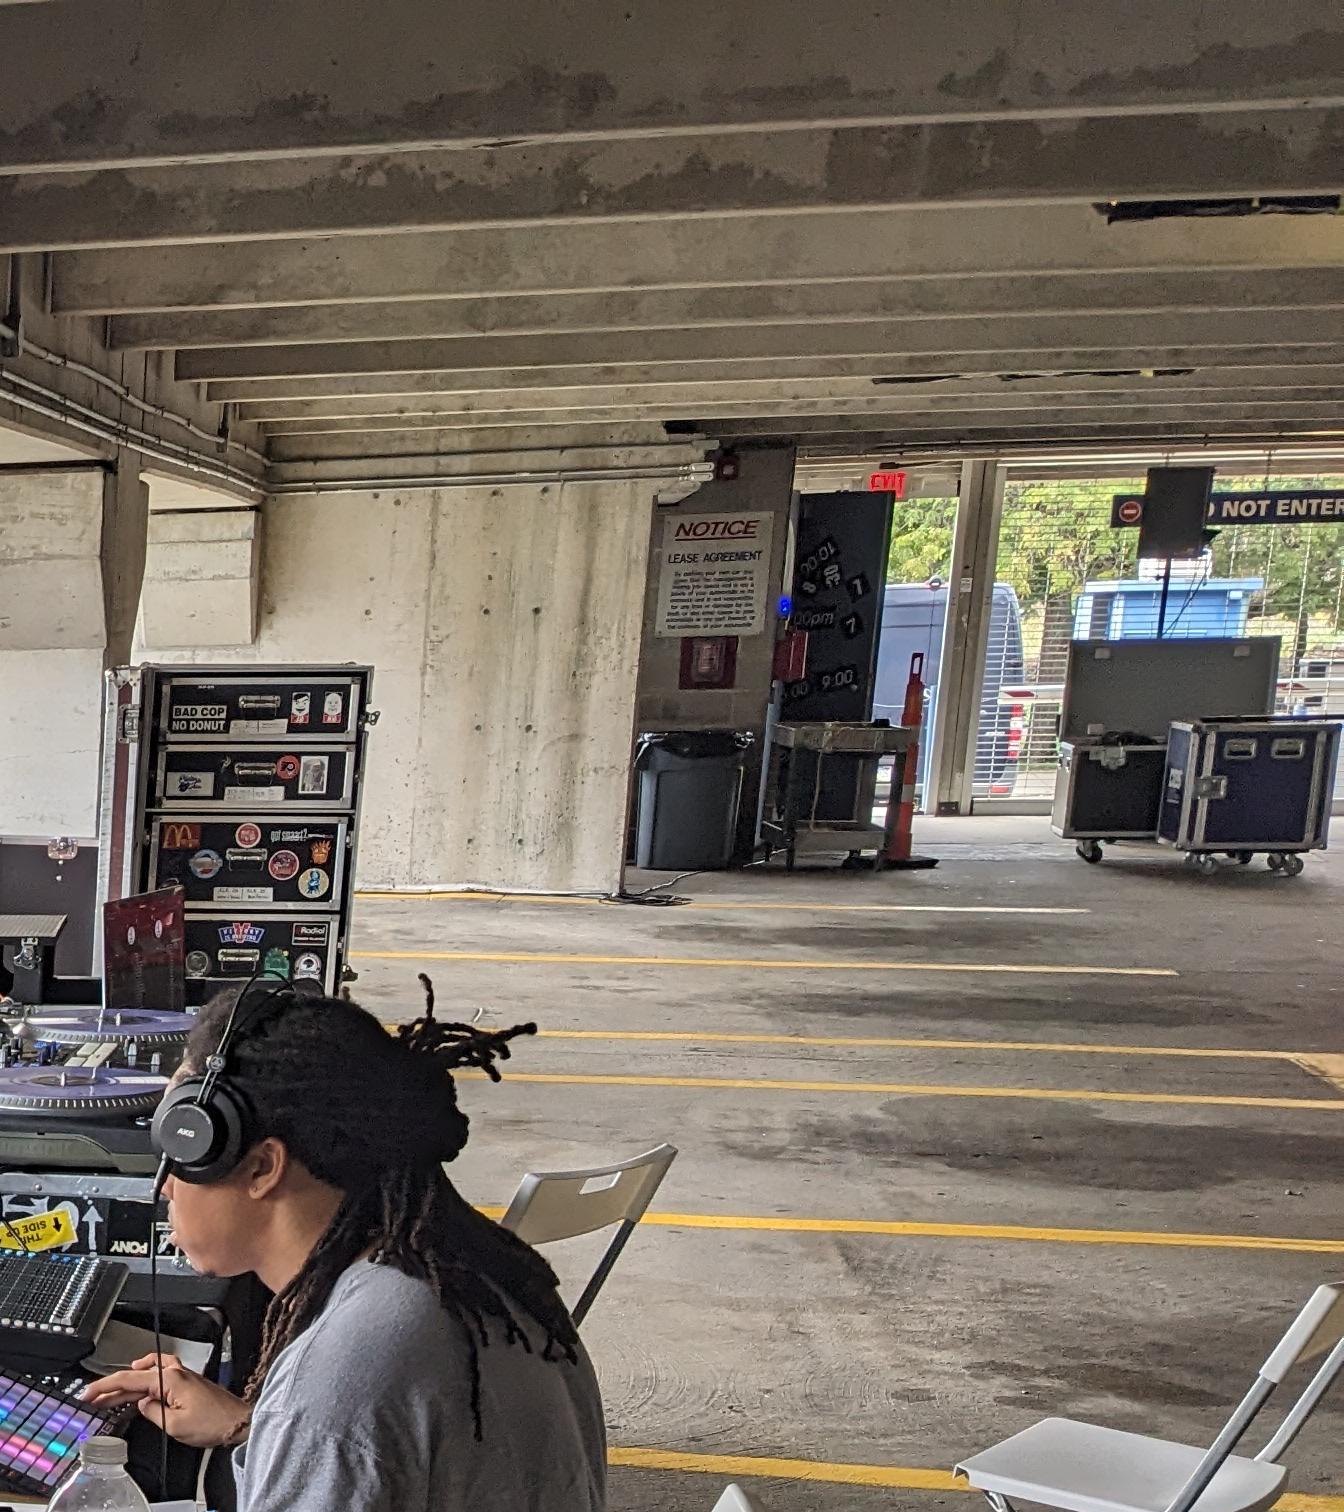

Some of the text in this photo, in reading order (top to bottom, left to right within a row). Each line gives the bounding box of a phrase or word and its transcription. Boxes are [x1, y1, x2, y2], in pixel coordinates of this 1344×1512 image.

[1222, 500, 1272, 517] NOT
[675, 519, 761, 538] NOTICE
[668, 550, 763, 564] LEASE AGREEMENT
[173, 706, 225, 718] BAD COP
[172, 720, 188, 731] NO
[189, 720, 226, 731] DONUT
[300, 926, 326, 936] Radial
[21, 1220, 47, 1234] SIDE
[110, 1240, 149, 1255] PONY
